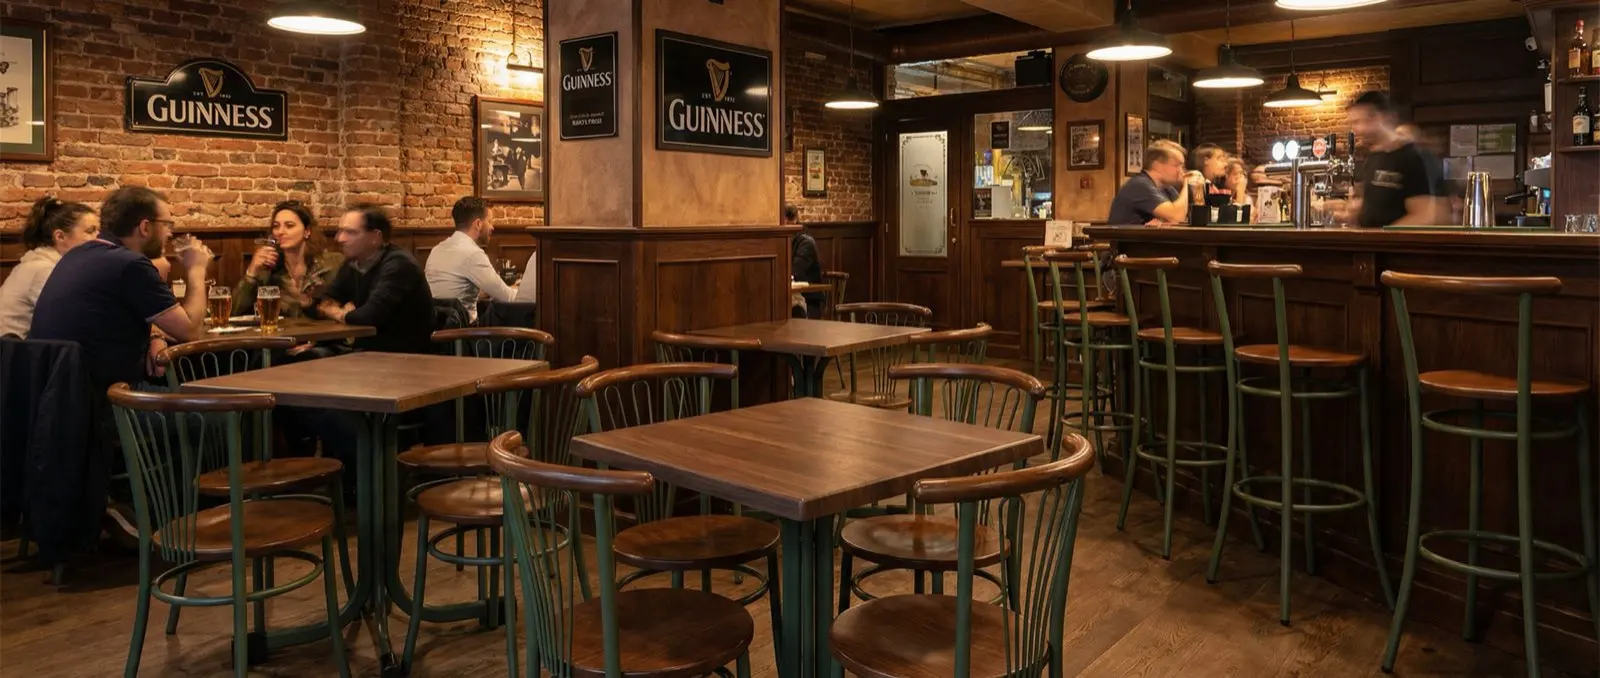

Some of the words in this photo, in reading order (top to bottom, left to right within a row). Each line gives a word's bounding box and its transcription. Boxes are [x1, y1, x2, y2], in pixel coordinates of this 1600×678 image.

[562, 71, 612, 91] GUINNESS
[147, 94, 273, 129] GUINNESS
[669, 99, 764, 138] GUINNESS
